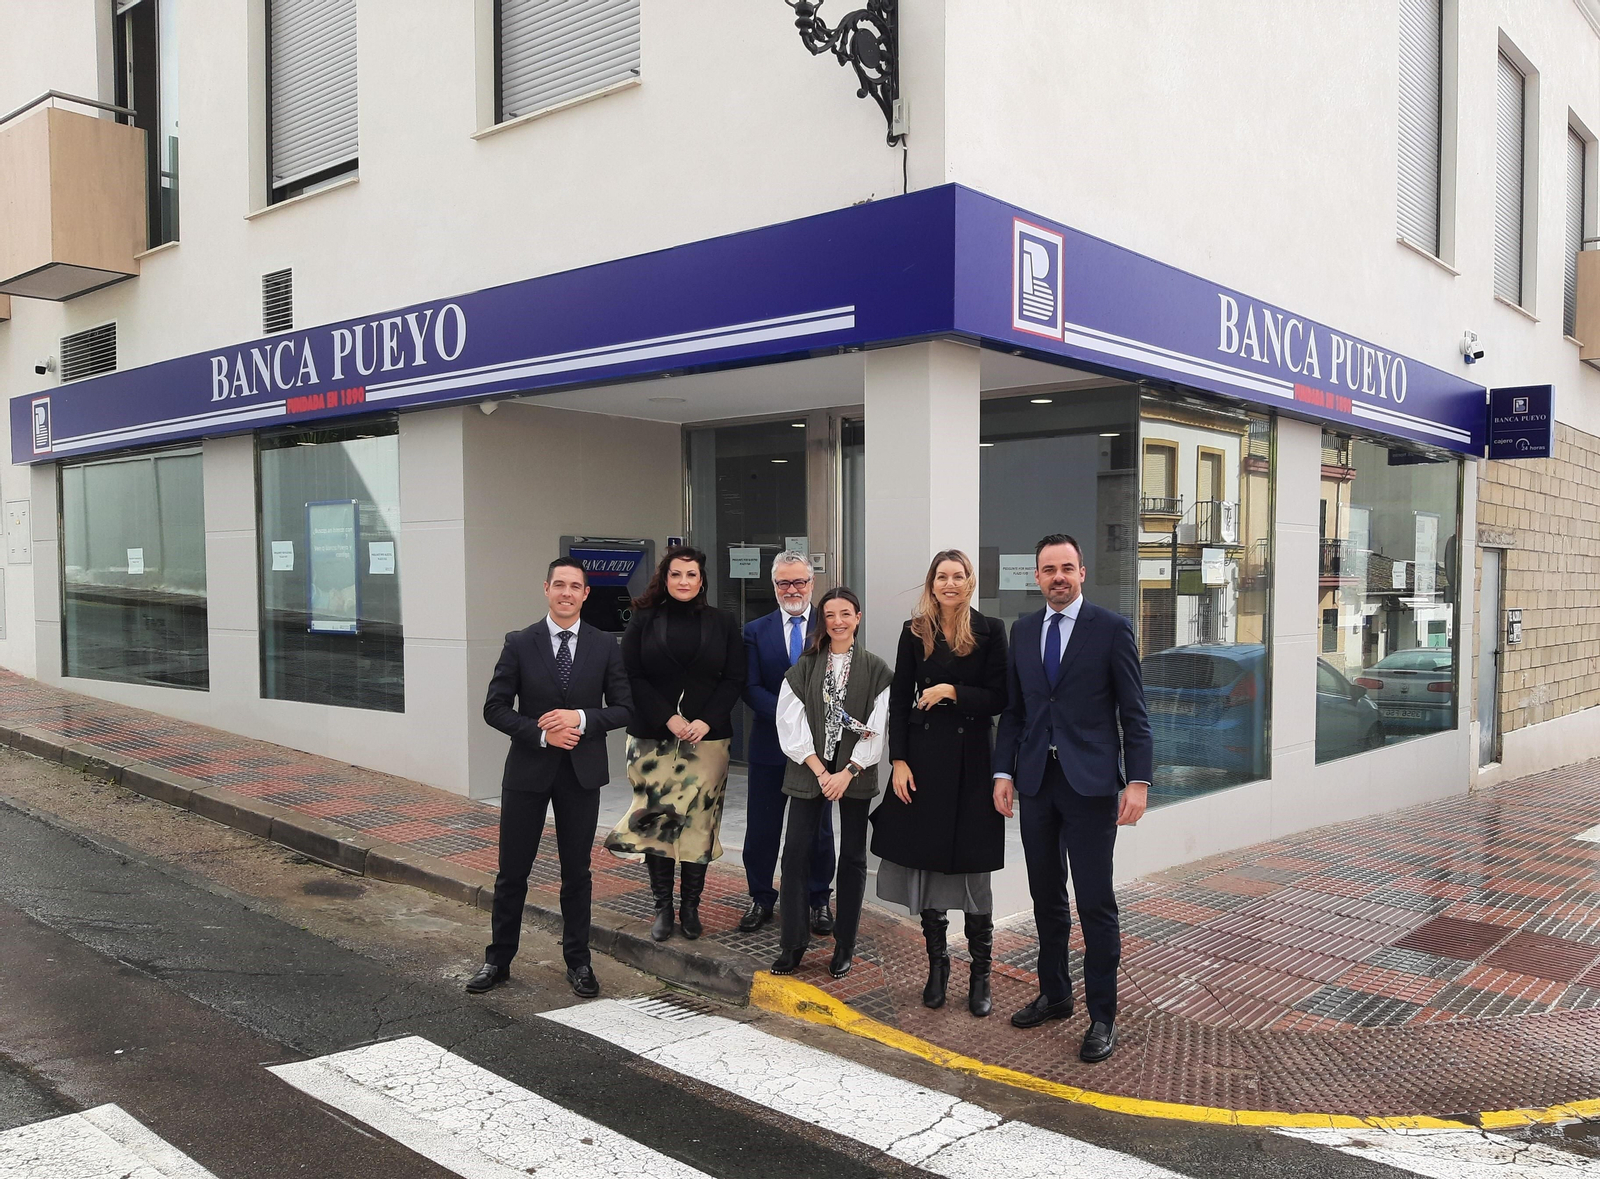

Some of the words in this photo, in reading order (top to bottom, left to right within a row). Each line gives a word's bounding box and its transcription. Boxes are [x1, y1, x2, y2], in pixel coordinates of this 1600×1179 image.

[210, 336, 320, 402] BANCA
[331, 303, 467, 380] PUEYO
[1217, 293, 1321, 379] BANCA
[1329, 334, 1407, 404] PUEYO
[287, 393, 325, 414] FUNDADA
[326, 391, 338, 408] EN
[341, 386, 365, 406] 1890
[1521, 414, 1546, 422] PUEYO
[607, 560, 635, 571] PUEYO
